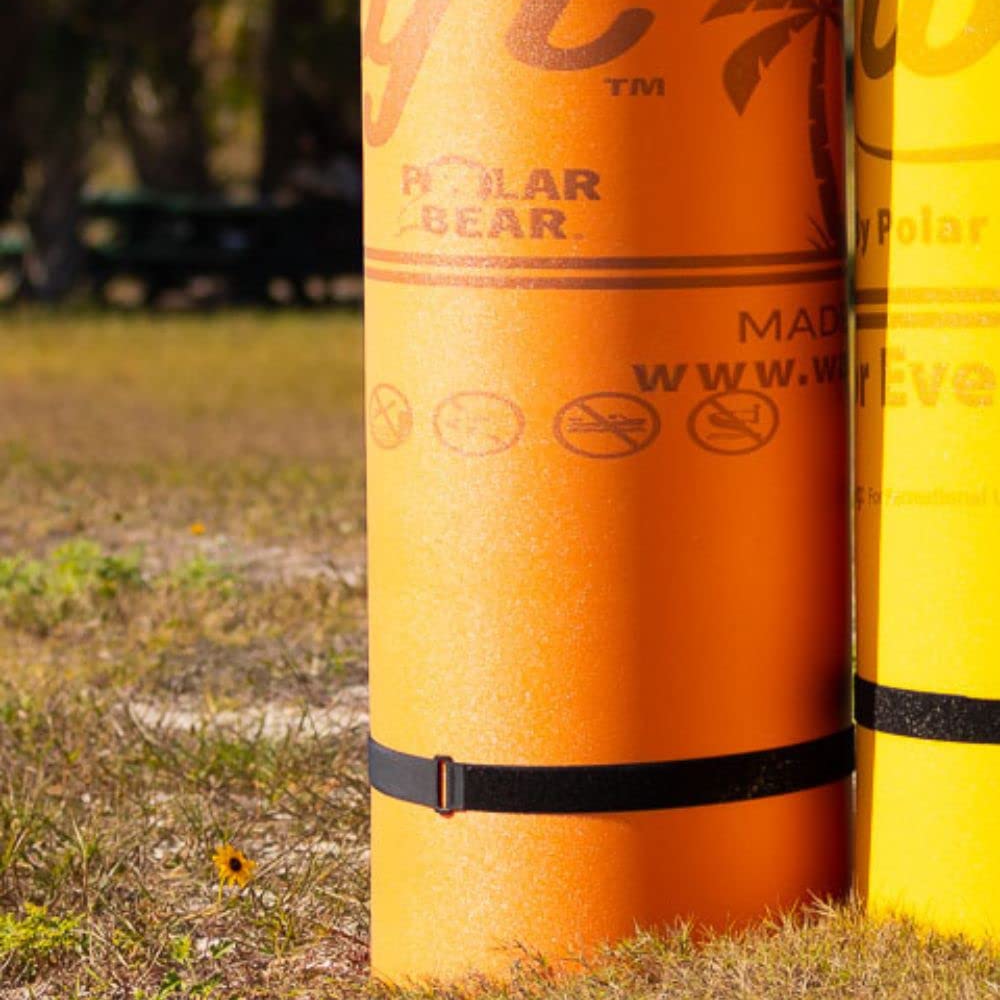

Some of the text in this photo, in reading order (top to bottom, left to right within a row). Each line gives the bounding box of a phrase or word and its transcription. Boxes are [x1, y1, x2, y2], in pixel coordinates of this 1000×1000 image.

[602, 76, 666, 97] TM
[877, 204, 988, 246] Polar
[738, 305, 843, 344] MAD
[632, 354, 845, 393] www.w
